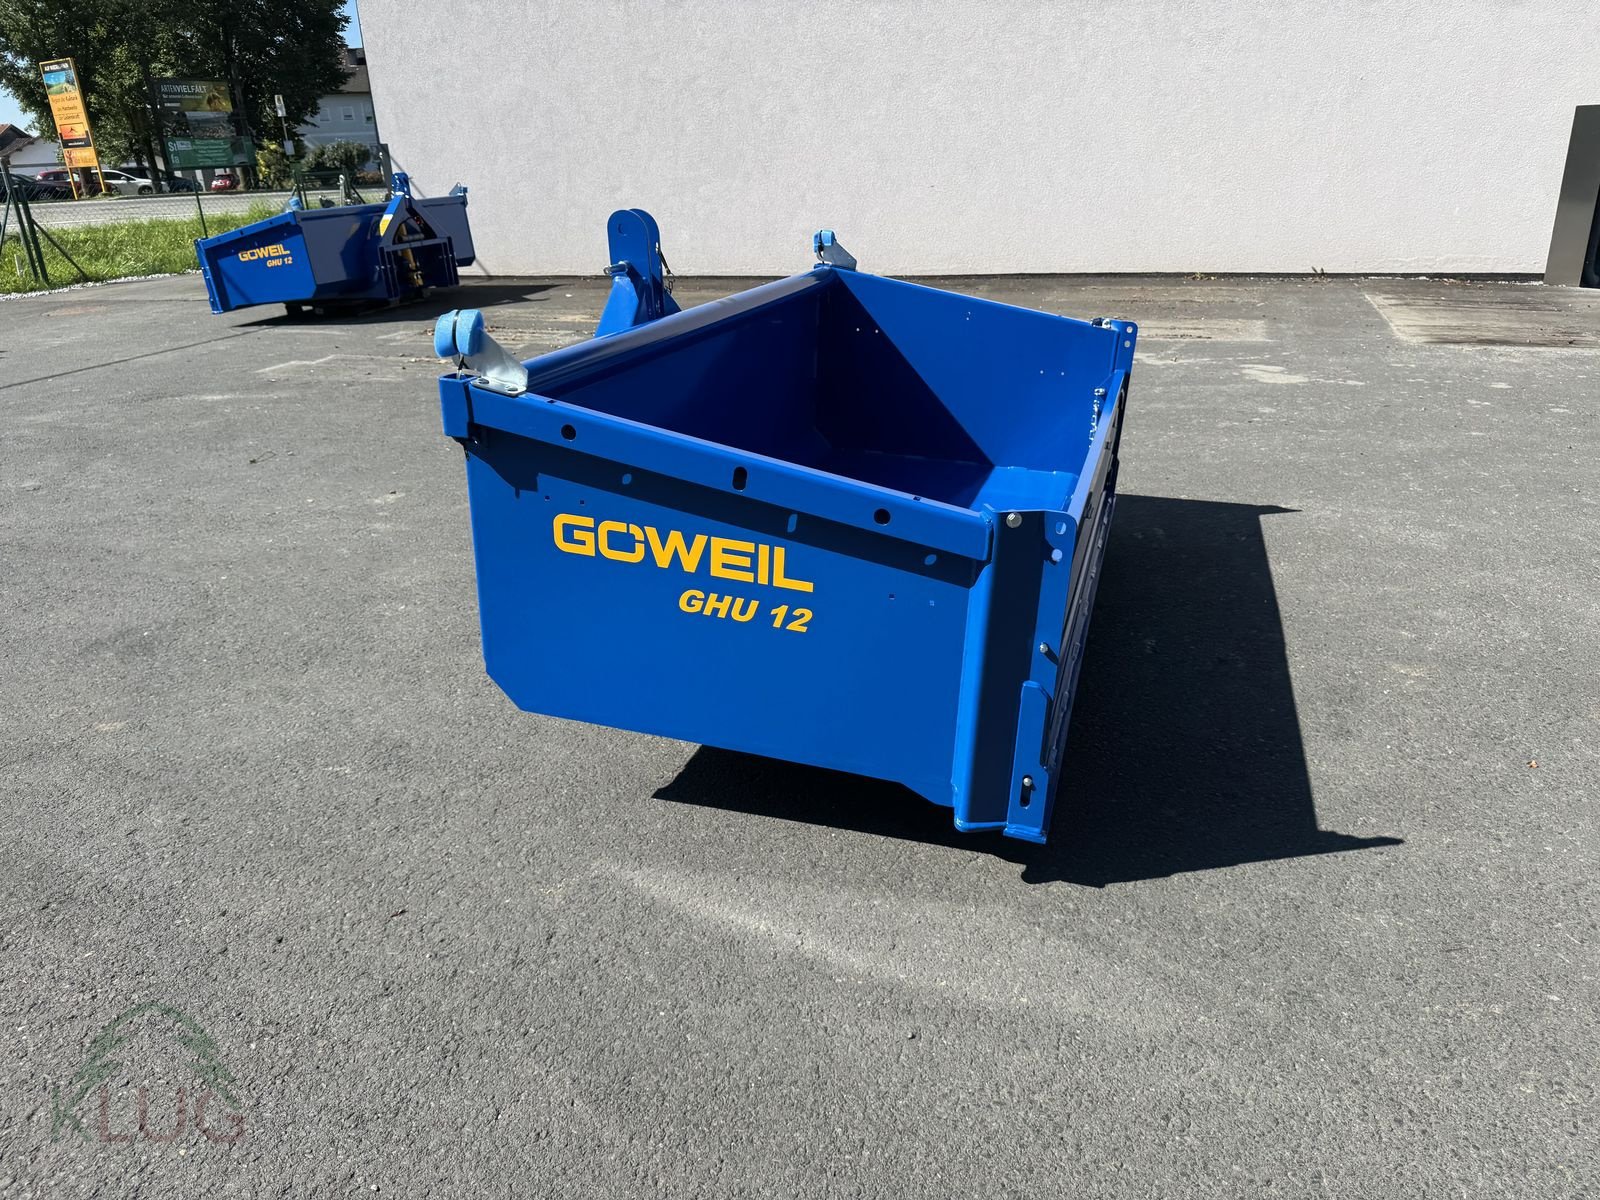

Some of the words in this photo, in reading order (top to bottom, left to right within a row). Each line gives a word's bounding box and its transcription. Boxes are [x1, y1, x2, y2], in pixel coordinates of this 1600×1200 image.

[267, 259, 282, 267] GHU
[678, 589, 760, 622] GHU
[769, 604, 813, 633] 12
